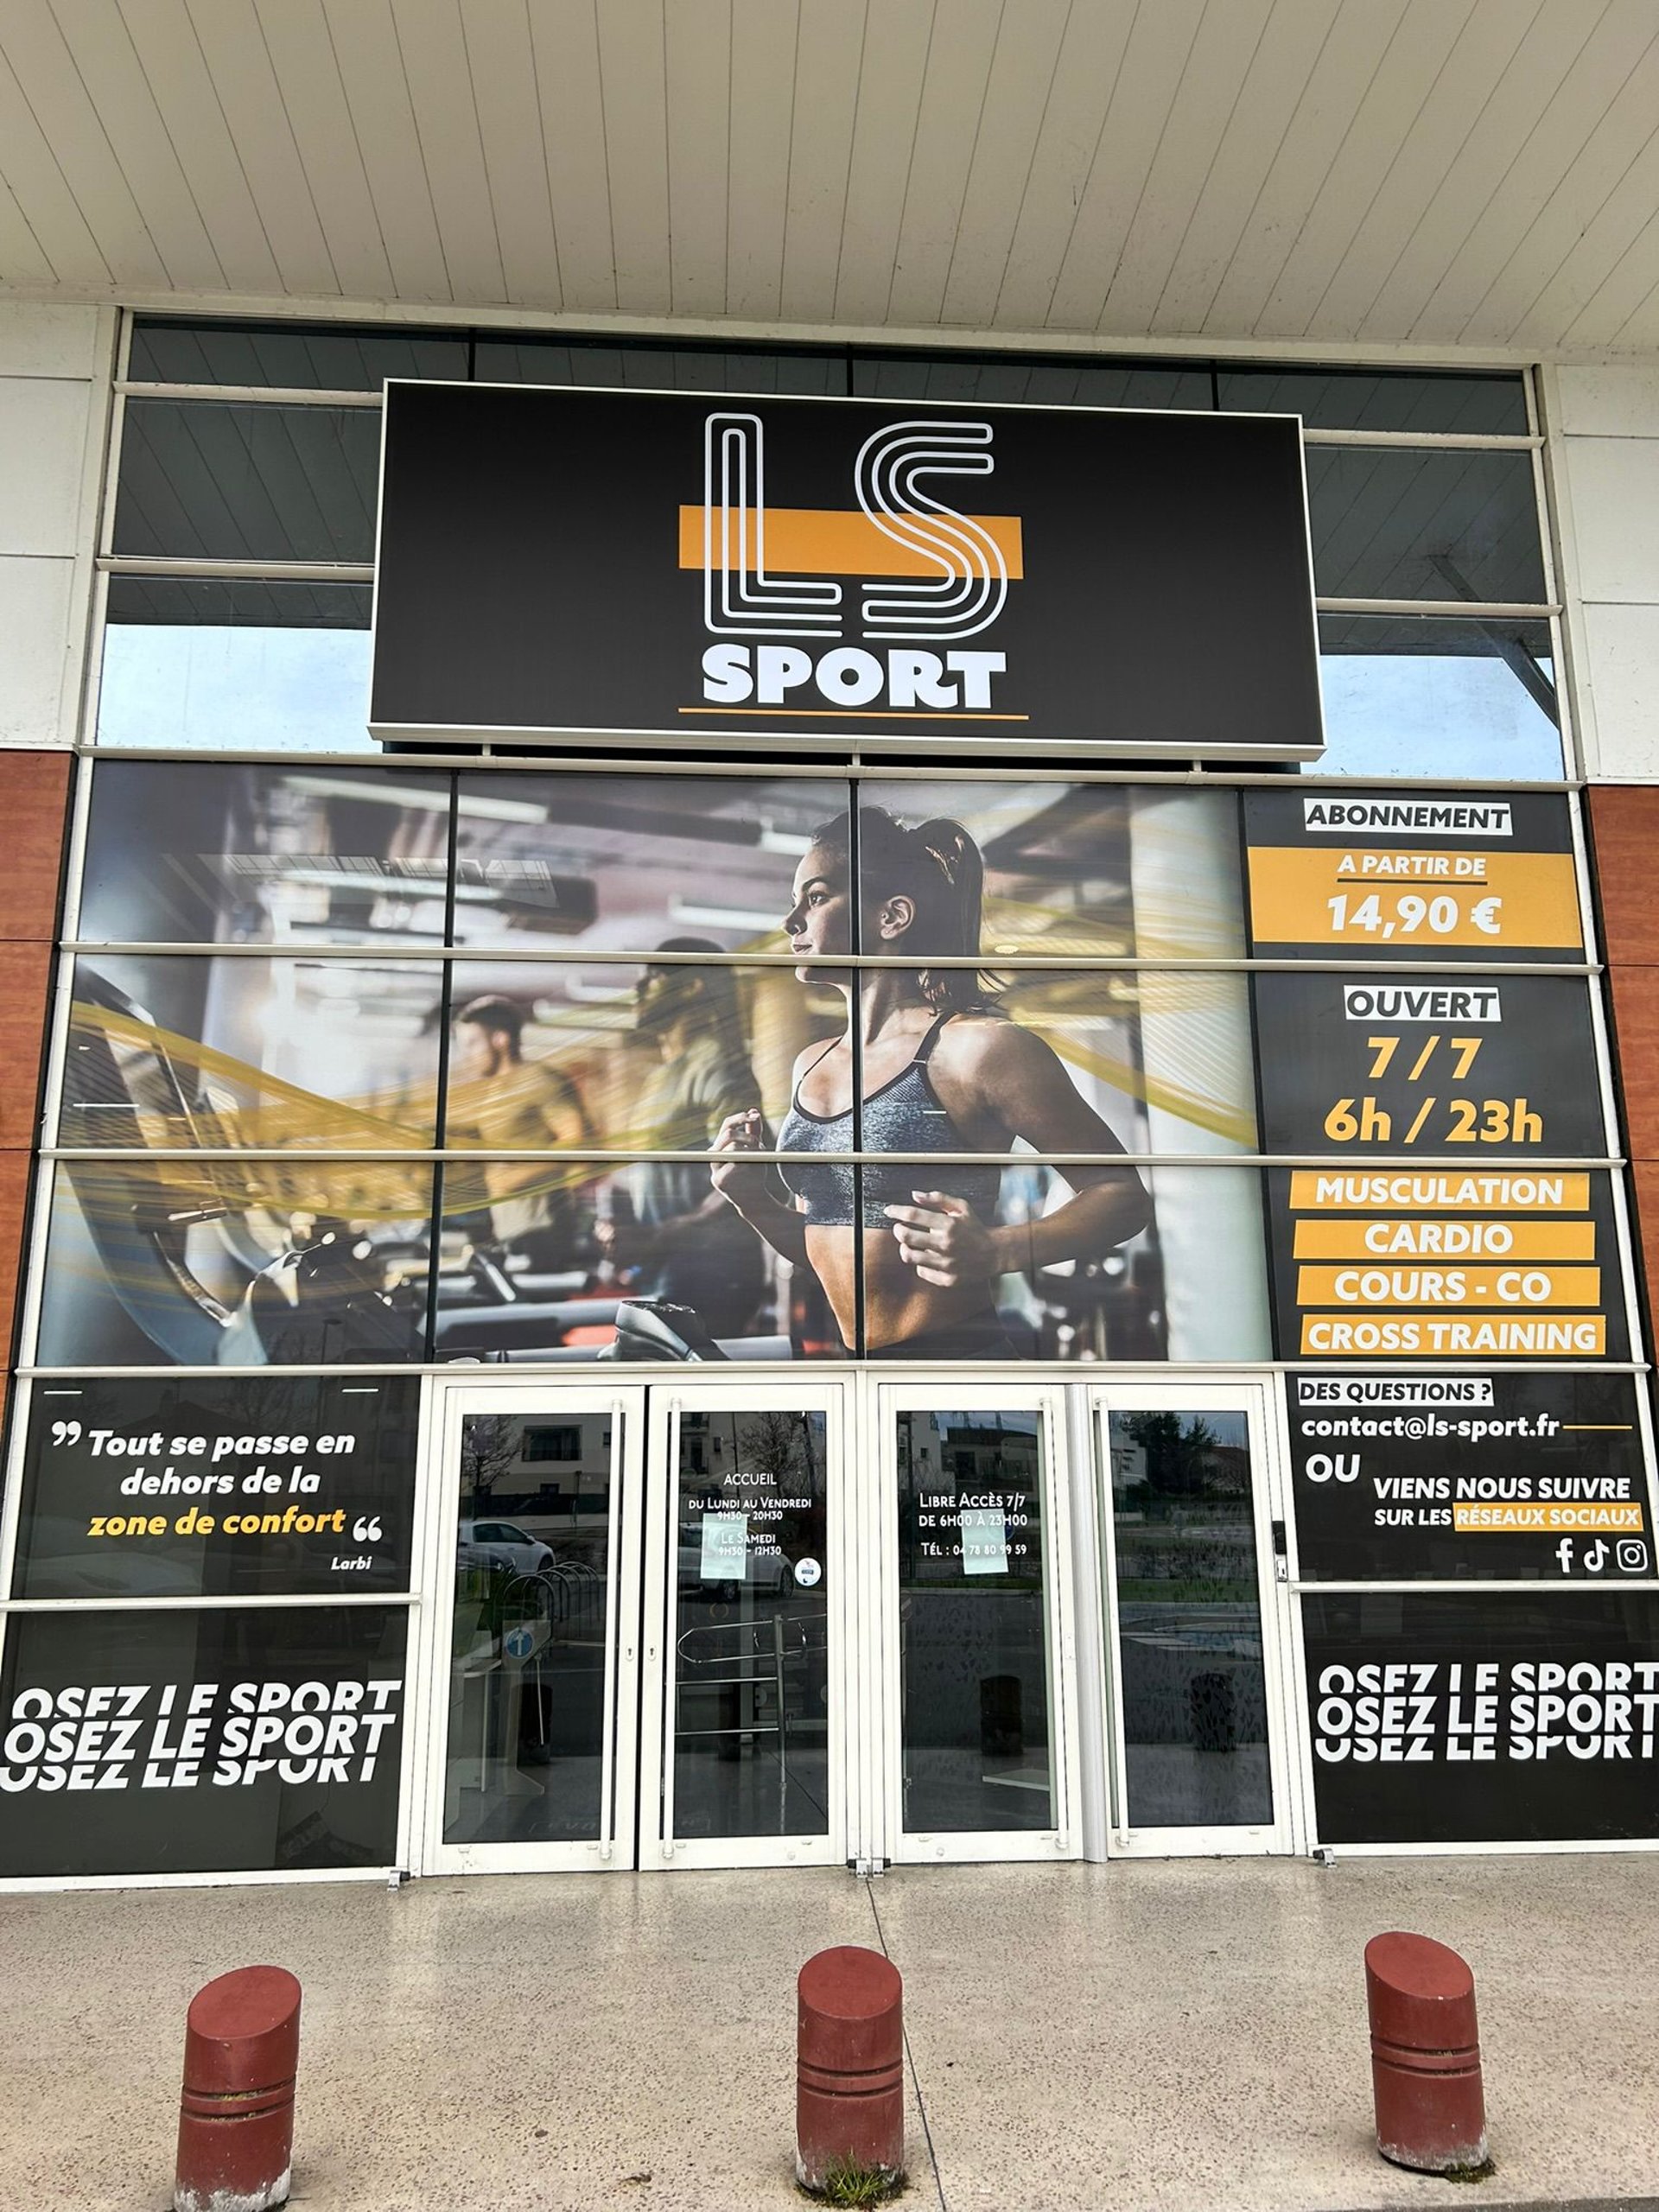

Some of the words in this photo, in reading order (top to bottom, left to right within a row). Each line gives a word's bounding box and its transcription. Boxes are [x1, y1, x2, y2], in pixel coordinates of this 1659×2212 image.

[704, 412, 1007, 640] LS
[702, 643, 1007, 709] SPORT
[1306, 804, 1510, 829] ABONNEMENT
[1338, 855, 1357, 873] A
[1362, 855, 1449, 875] PARTIR
[1455, 858, 1486, 876] DE
[1327, 894, 1459, 938] 14,90
[1471, 897, 1502, 934] €
[1346, 991, 1497, 1019] OUVERT
[1324, 1097, 1392, 1141] 6h
[1445, 1098, 1543, 1143] 23h
[1315, 1177, 1564, 1205] MUSCULATION
[1364, 1224, 1513, 1253] CARDIO
[1334, 1271, 1466, 1301] COURS
[1497, 1272, 1552, 1301] CO
[1308, 1323, 1420, 1350] CROSS
[1427, 1323, 1596, 1350] TRAINING
[1300, 1382, 1340, 1401] DES
[1346, 1382, 1475, 1403] QUESTIONS
[1300, 1414, 1560, 1442] contact@ls-sport.fr
[88, 1430, 162, 1457] Tout
[169, 1437, 207, 1455] se
[212, 1434, 308, 1462] passe
[316, 1434, 355, 1454] en
[120, 1467, 234, 1496] dehors
[242, 1466, 283, 1494] de
[288, 1466, 321, 1493] la
[723, 1473, 778, 1485] ACCUEIL
[1305, 1453, 1361, 1483] OU
[1007, 1492, 1026, 1511] 7/7
[1373, 1478, 1450, 1499] VIENS
[1456, 1478, 1532, 1499] NOUS
[1537, 1478, 1631, 1499] SUIVRE
[87, 1516, 167, 1536] zone
[175, 1507, 214, 1535] de
[222, 1505, 346, 1535] confort
[753, 1511, 783, 1520] 20H30
[918, 1516, 936, 1527] DE
[939, 1515, 972, 1527] 6H00
[989, 1514, 1027, 1526] 23H00
[1374, 1509, 1414, 1526] SUR
[1419, 1509, 1452, 1526] LES
[1456, 1504, 1544, 1526] RÉSEAUX
[1549, 1508, 1640, 1526] SOCIAUX
[754, 1546, 781, 1555] 12H30
[1015, 1544, 1027, 1554] 59
[331, 1556, 372, 1571] Larbi
[1317, 1695, 1437, 1735] OSEZ
[1447, 1695, 1498, 1733] LE
[1510, 1694, 1659, 1733] SPORT
[3, 1719, 144, 1764] OSEZ
[149, 1718, 213, 1760] LE
[219, 1713, 397, 1757] SPORT
